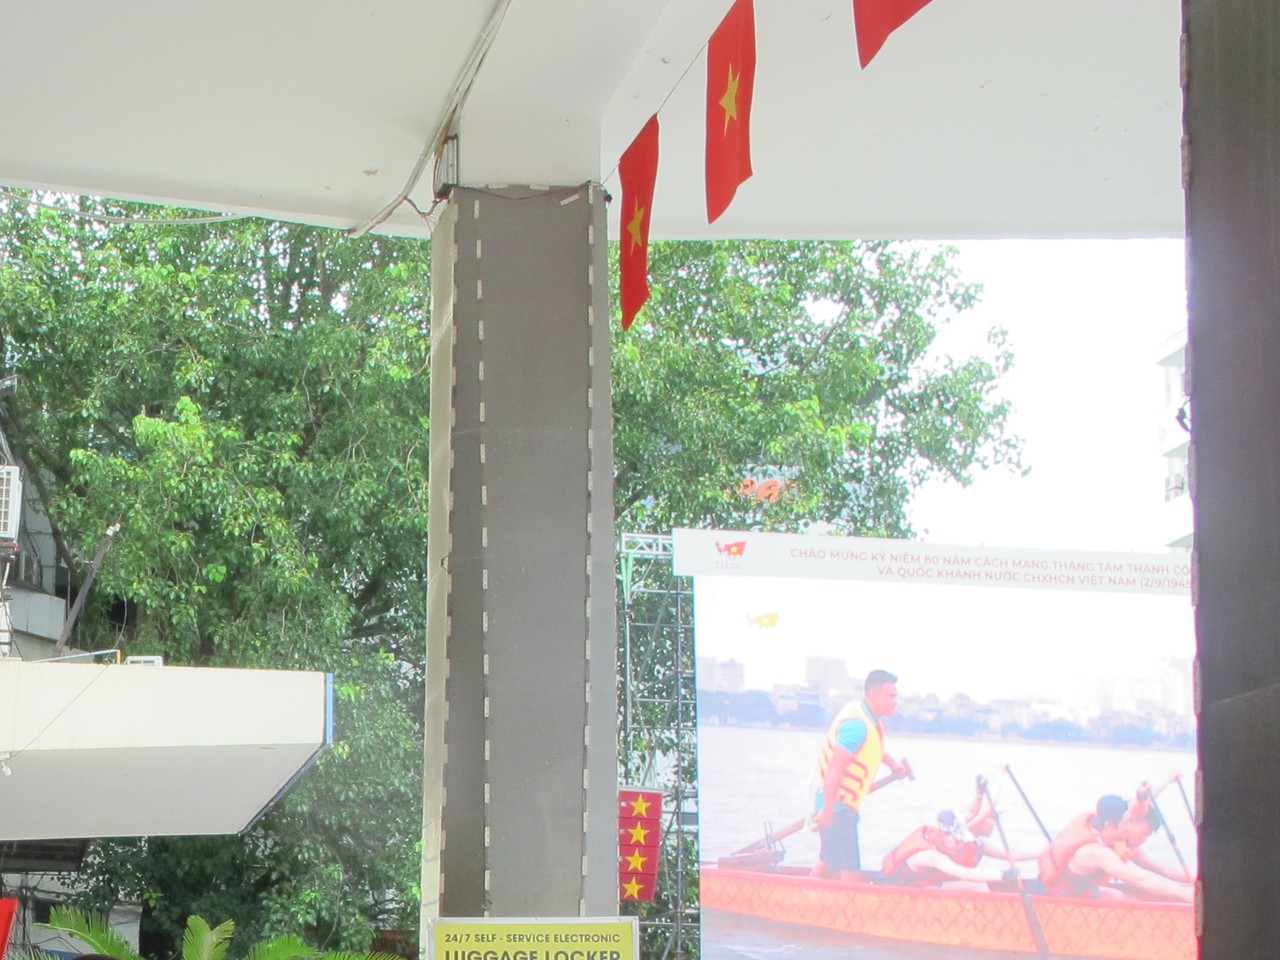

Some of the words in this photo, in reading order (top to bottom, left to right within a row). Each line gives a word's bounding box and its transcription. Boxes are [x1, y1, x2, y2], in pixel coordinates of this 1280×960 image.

[790, 548, 826, 559] CHÀO
[924, 555, 939, 565] 80
[1173, 564, 1191, 576] CÔ
[877, 565, 894, 576] VÀ
[937, 567, 981, 580] KHÁNH
[1023, 573, 1075, 584] CHXHCN
[1108, 576, 1136, 587] NAM
[445, 934, 470, 943] 24/7
[474, 934, 497, 943] SELF
[506, 934, 550, 943] SERVICE
[554, 934, 620, 943] ELECTRONIC
